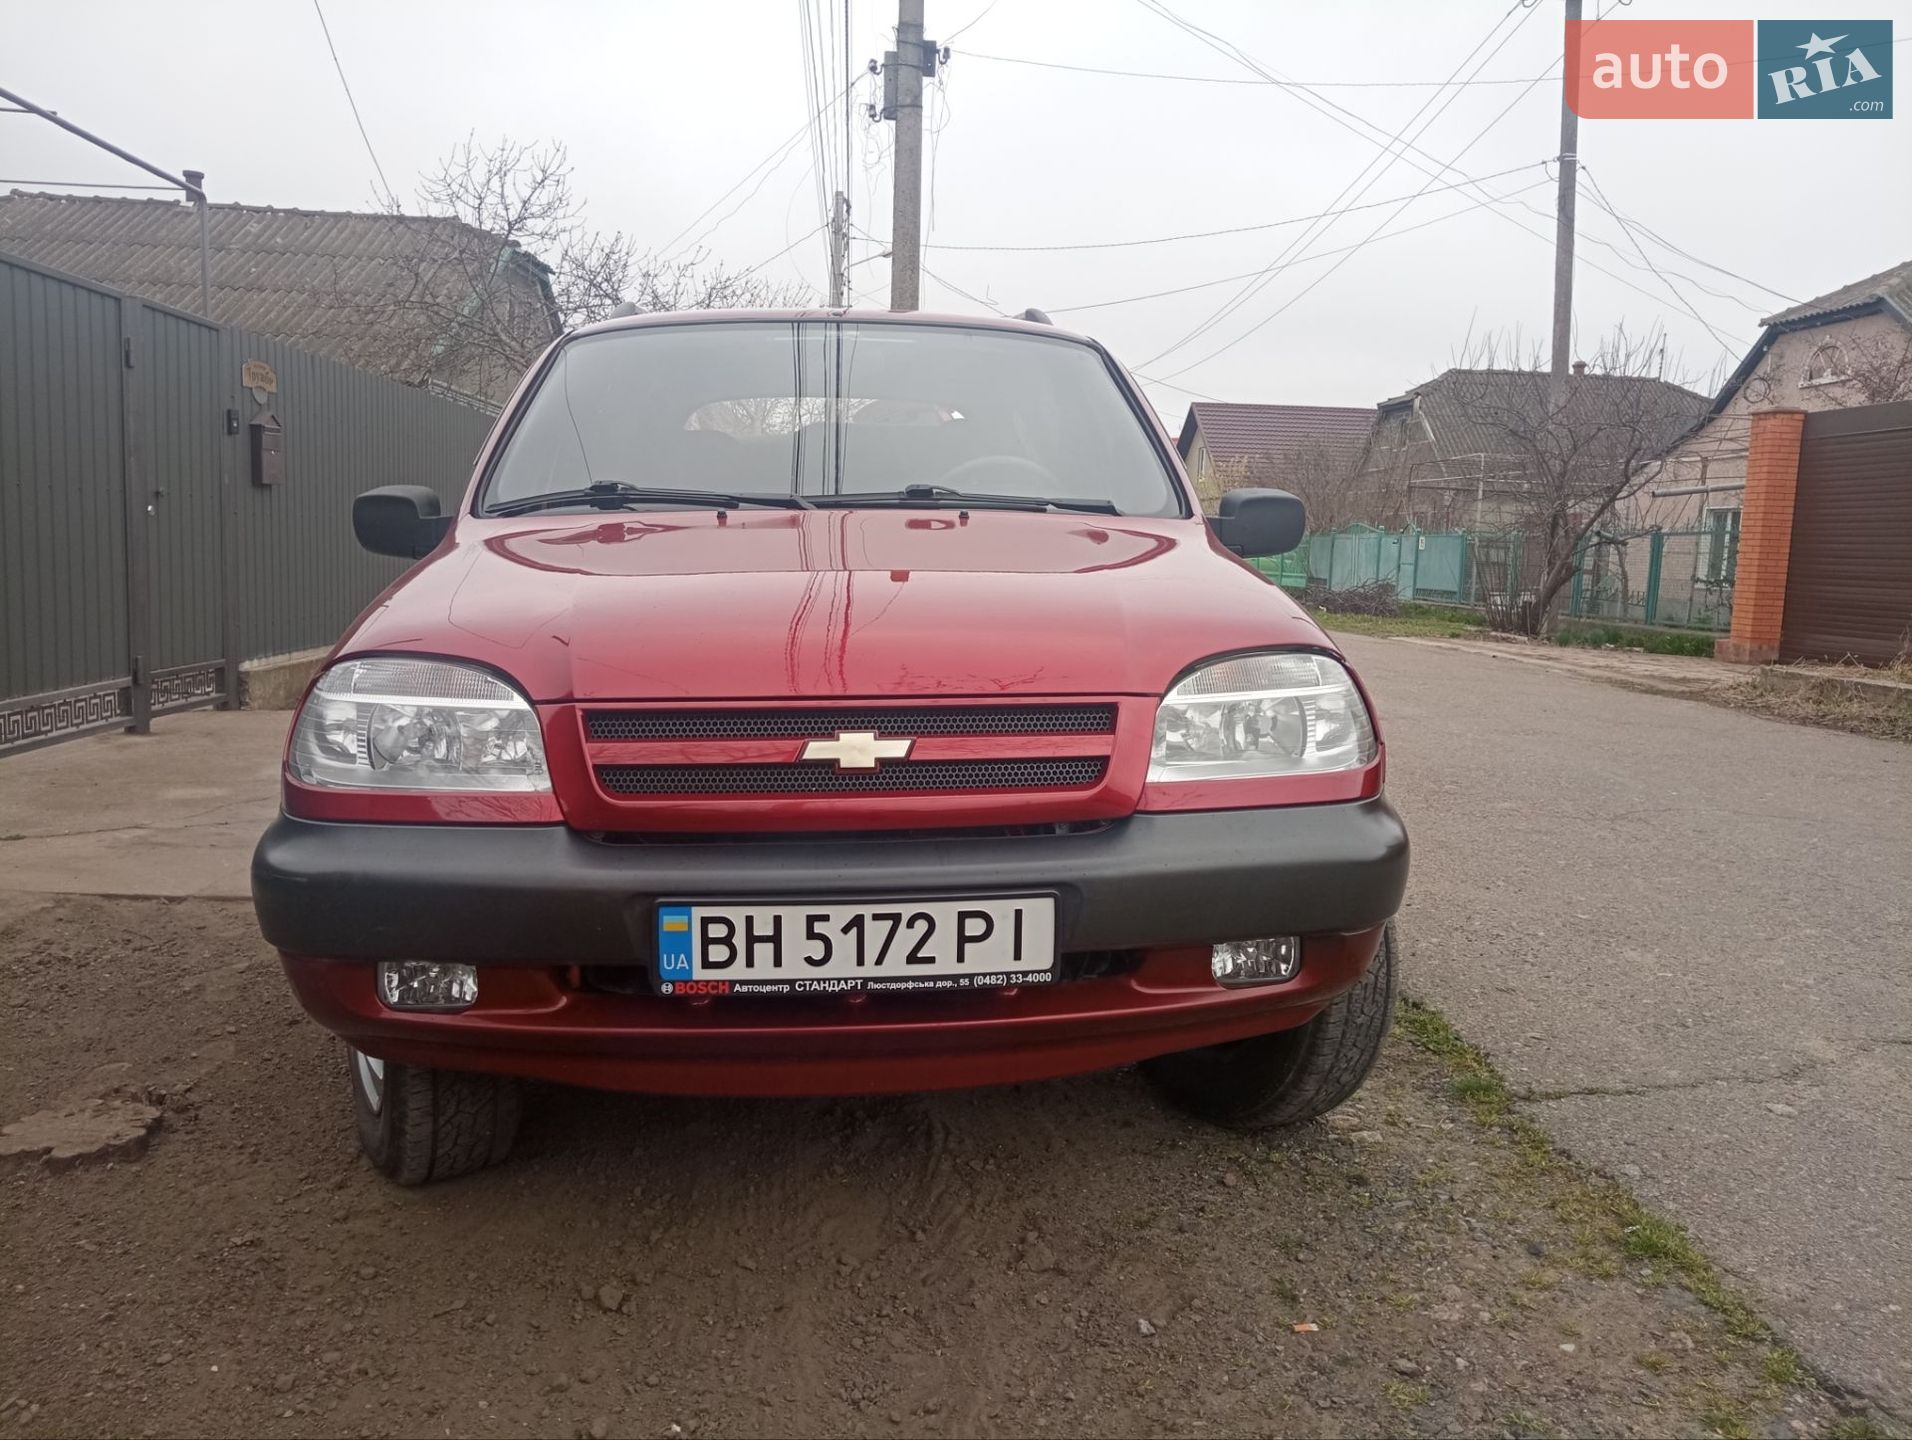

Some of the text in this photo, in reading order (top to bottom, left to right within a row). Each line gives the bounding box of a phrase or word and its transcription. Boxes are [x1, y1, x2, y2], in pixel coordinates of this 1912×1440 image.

[700, 913, 783, 970] BH
[803, 911, 936, 968] 5172
[663, 953, 689, 971] UA
[675, 981, 730, 995] BOSCH
[733, 982, 790, 994] Автоцентр
[795, 979, 864, 993] СТАНДАРТ
[973, 974, 1008, 987] (0482)
[1010, 972, 1052, 984] 33-4000
